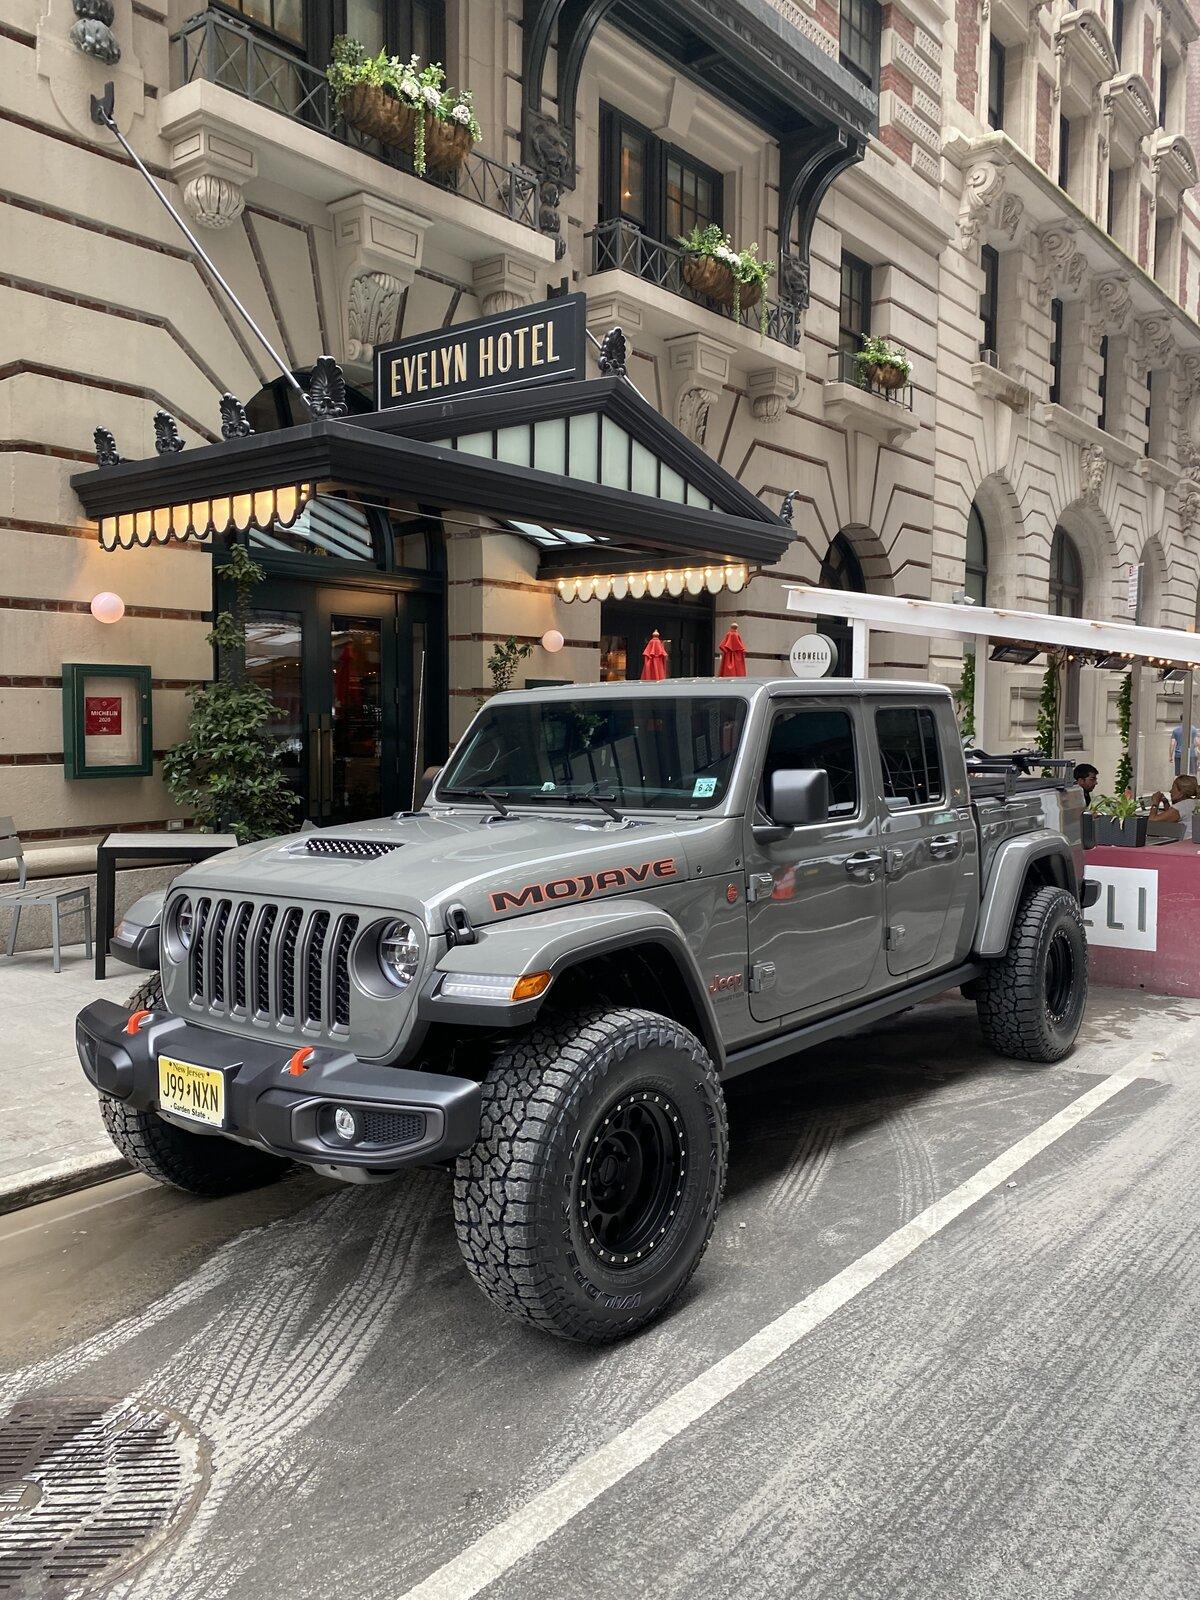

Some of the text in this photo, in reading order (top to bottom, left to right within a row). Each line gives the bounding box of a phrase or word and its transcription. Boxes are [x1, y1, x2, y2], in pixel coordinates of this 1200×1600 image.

[391, 321, 560, 398] EVELYN HOTEL
[793, 651, 828, 660] LEONELLI
[489, 857, 679, 913] MOJAVE
[708, 972, 742, 995] Jeep
[172, 1061, 205, 1080] New Jersey
[173, 1102, 206, 1119] Garden State
